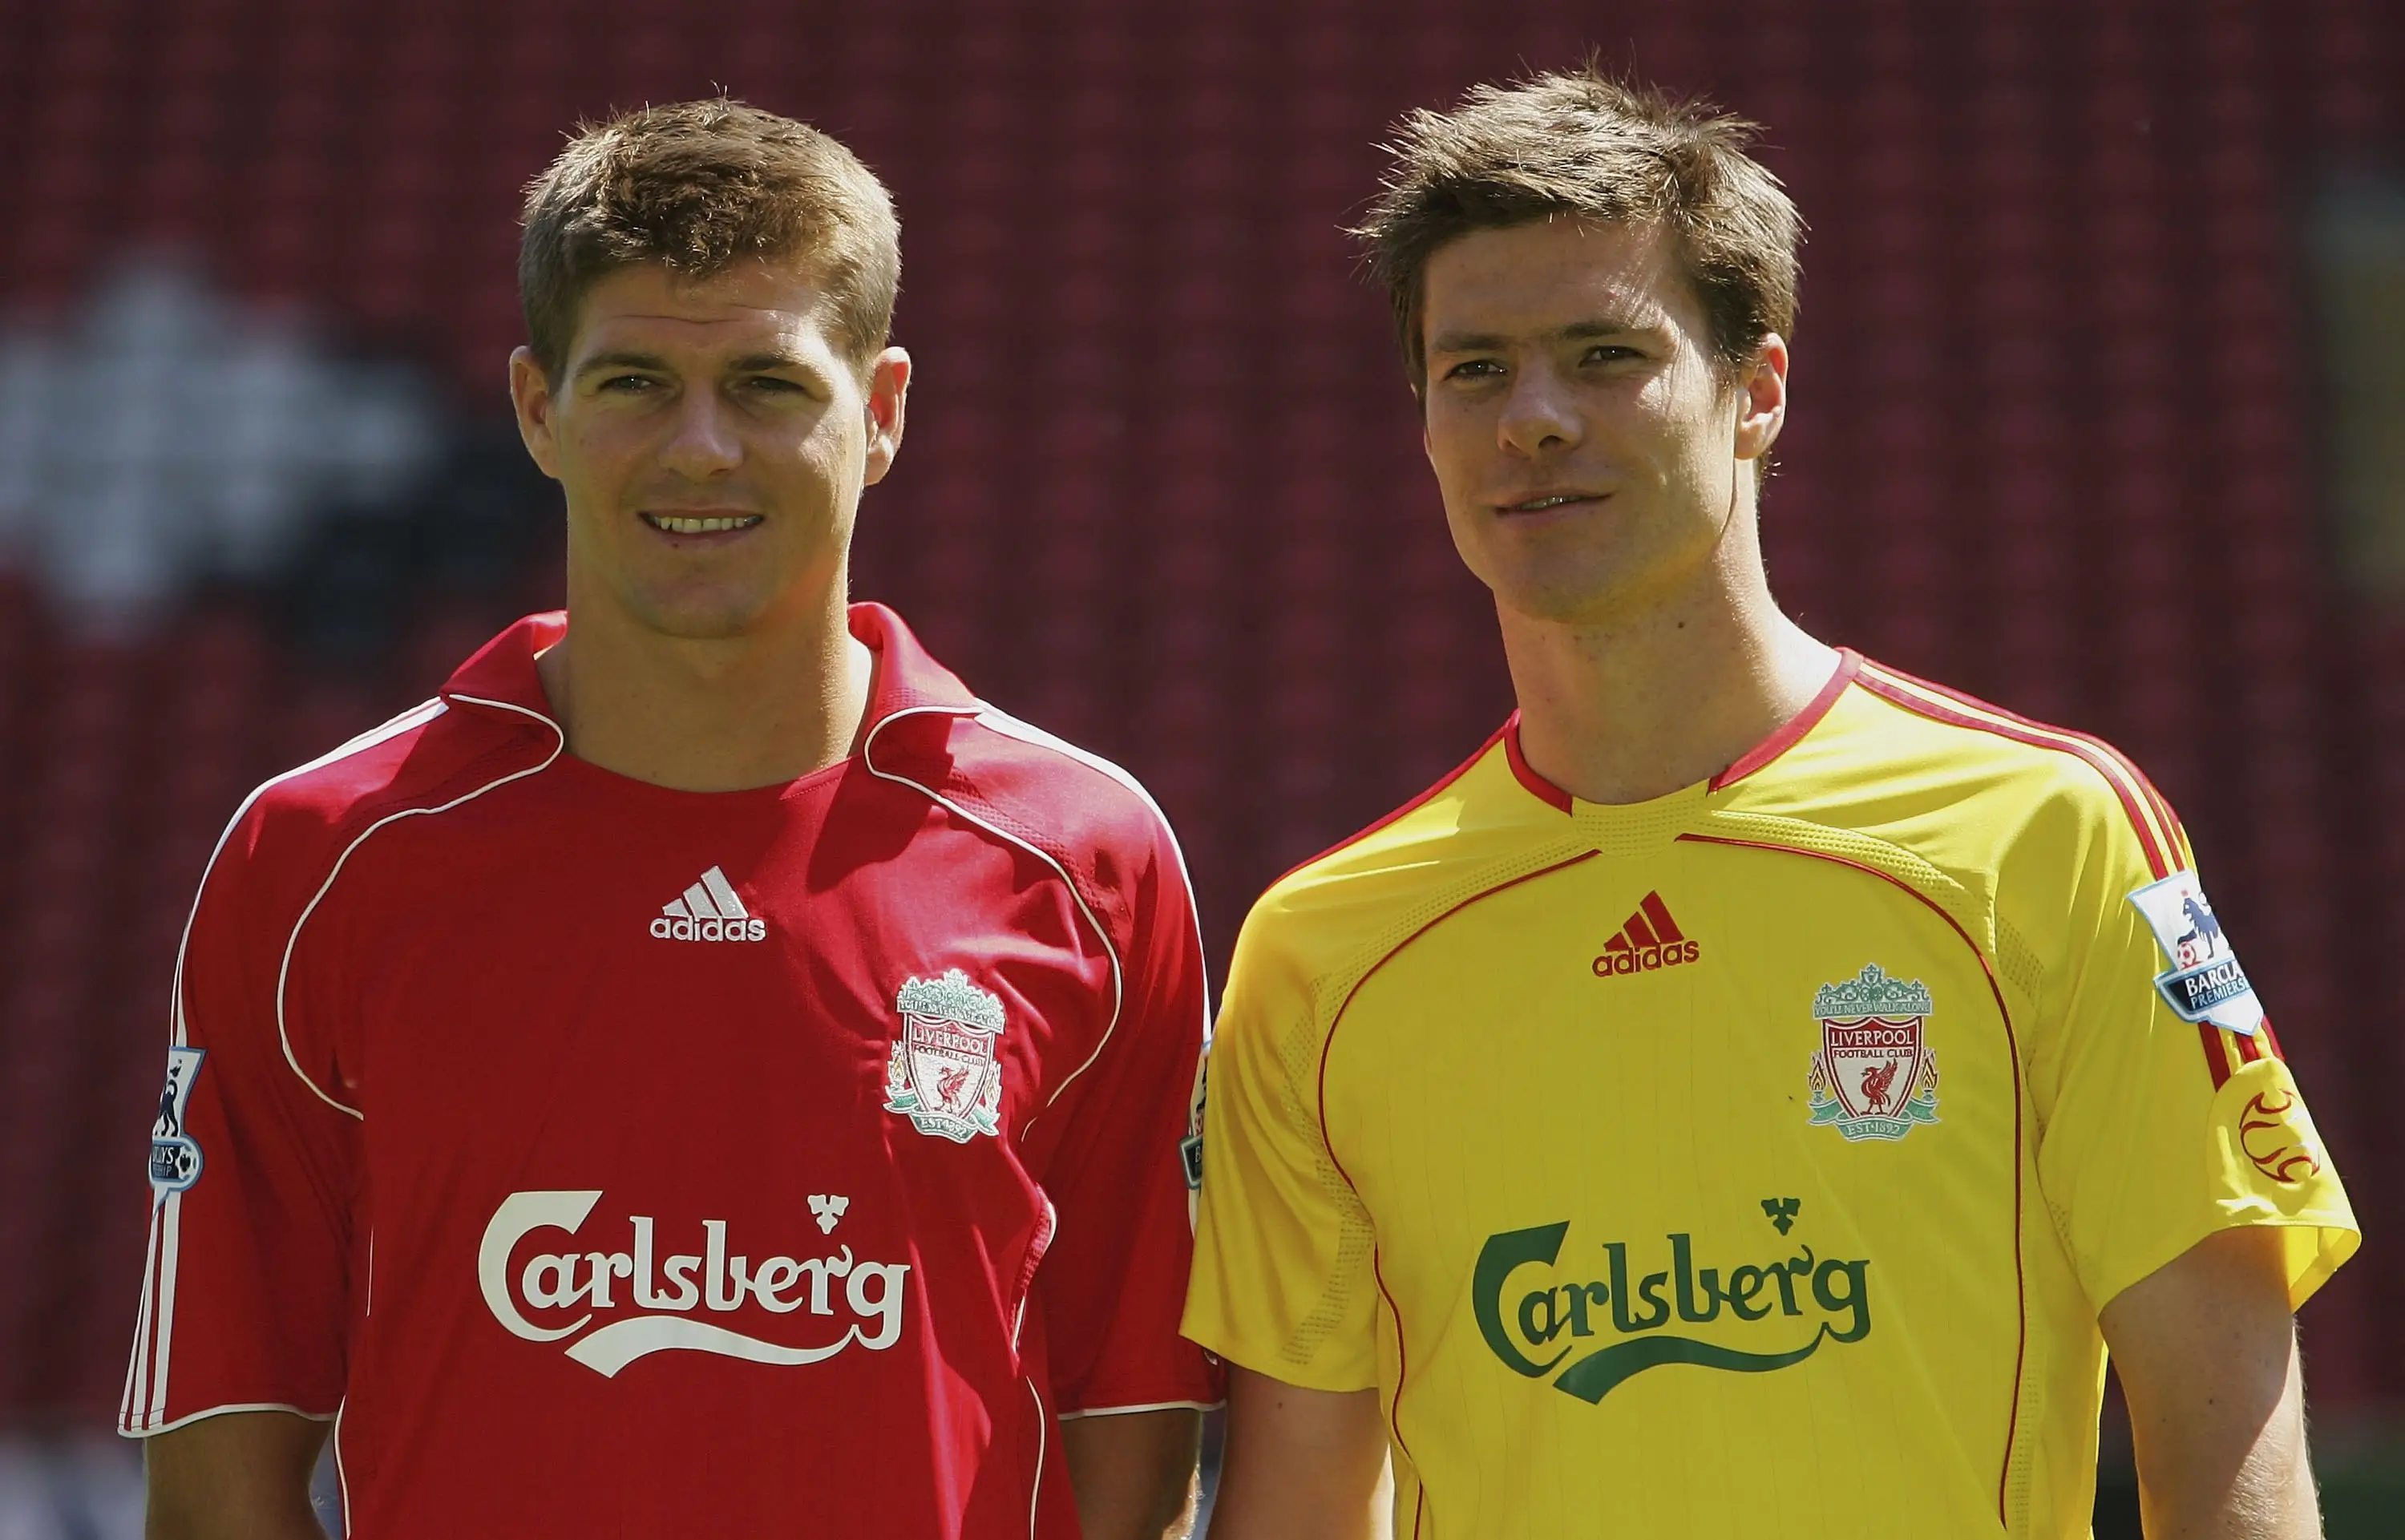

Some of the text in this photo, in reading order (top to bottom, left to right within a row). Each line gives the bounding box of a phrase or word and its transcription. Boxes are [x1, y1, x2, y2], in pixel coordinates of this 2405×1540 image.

[649, 915, 766, 942] adidas
[1592, 940, 1700, 977] adidas
[912, 1025, 988, 1056] LIVERPOOL
[1831, 1029, 1915, 1046] LIVERPOOL
[914, 1045, 984, 1066] FOOTBALL CLUB
[1833, 1048, 1913, 1058] FOOTBALL CLUB
[478, 1190, 911, 1378] Carlsberg
[1472, 1219, 1871, 1405] Carlsberg
